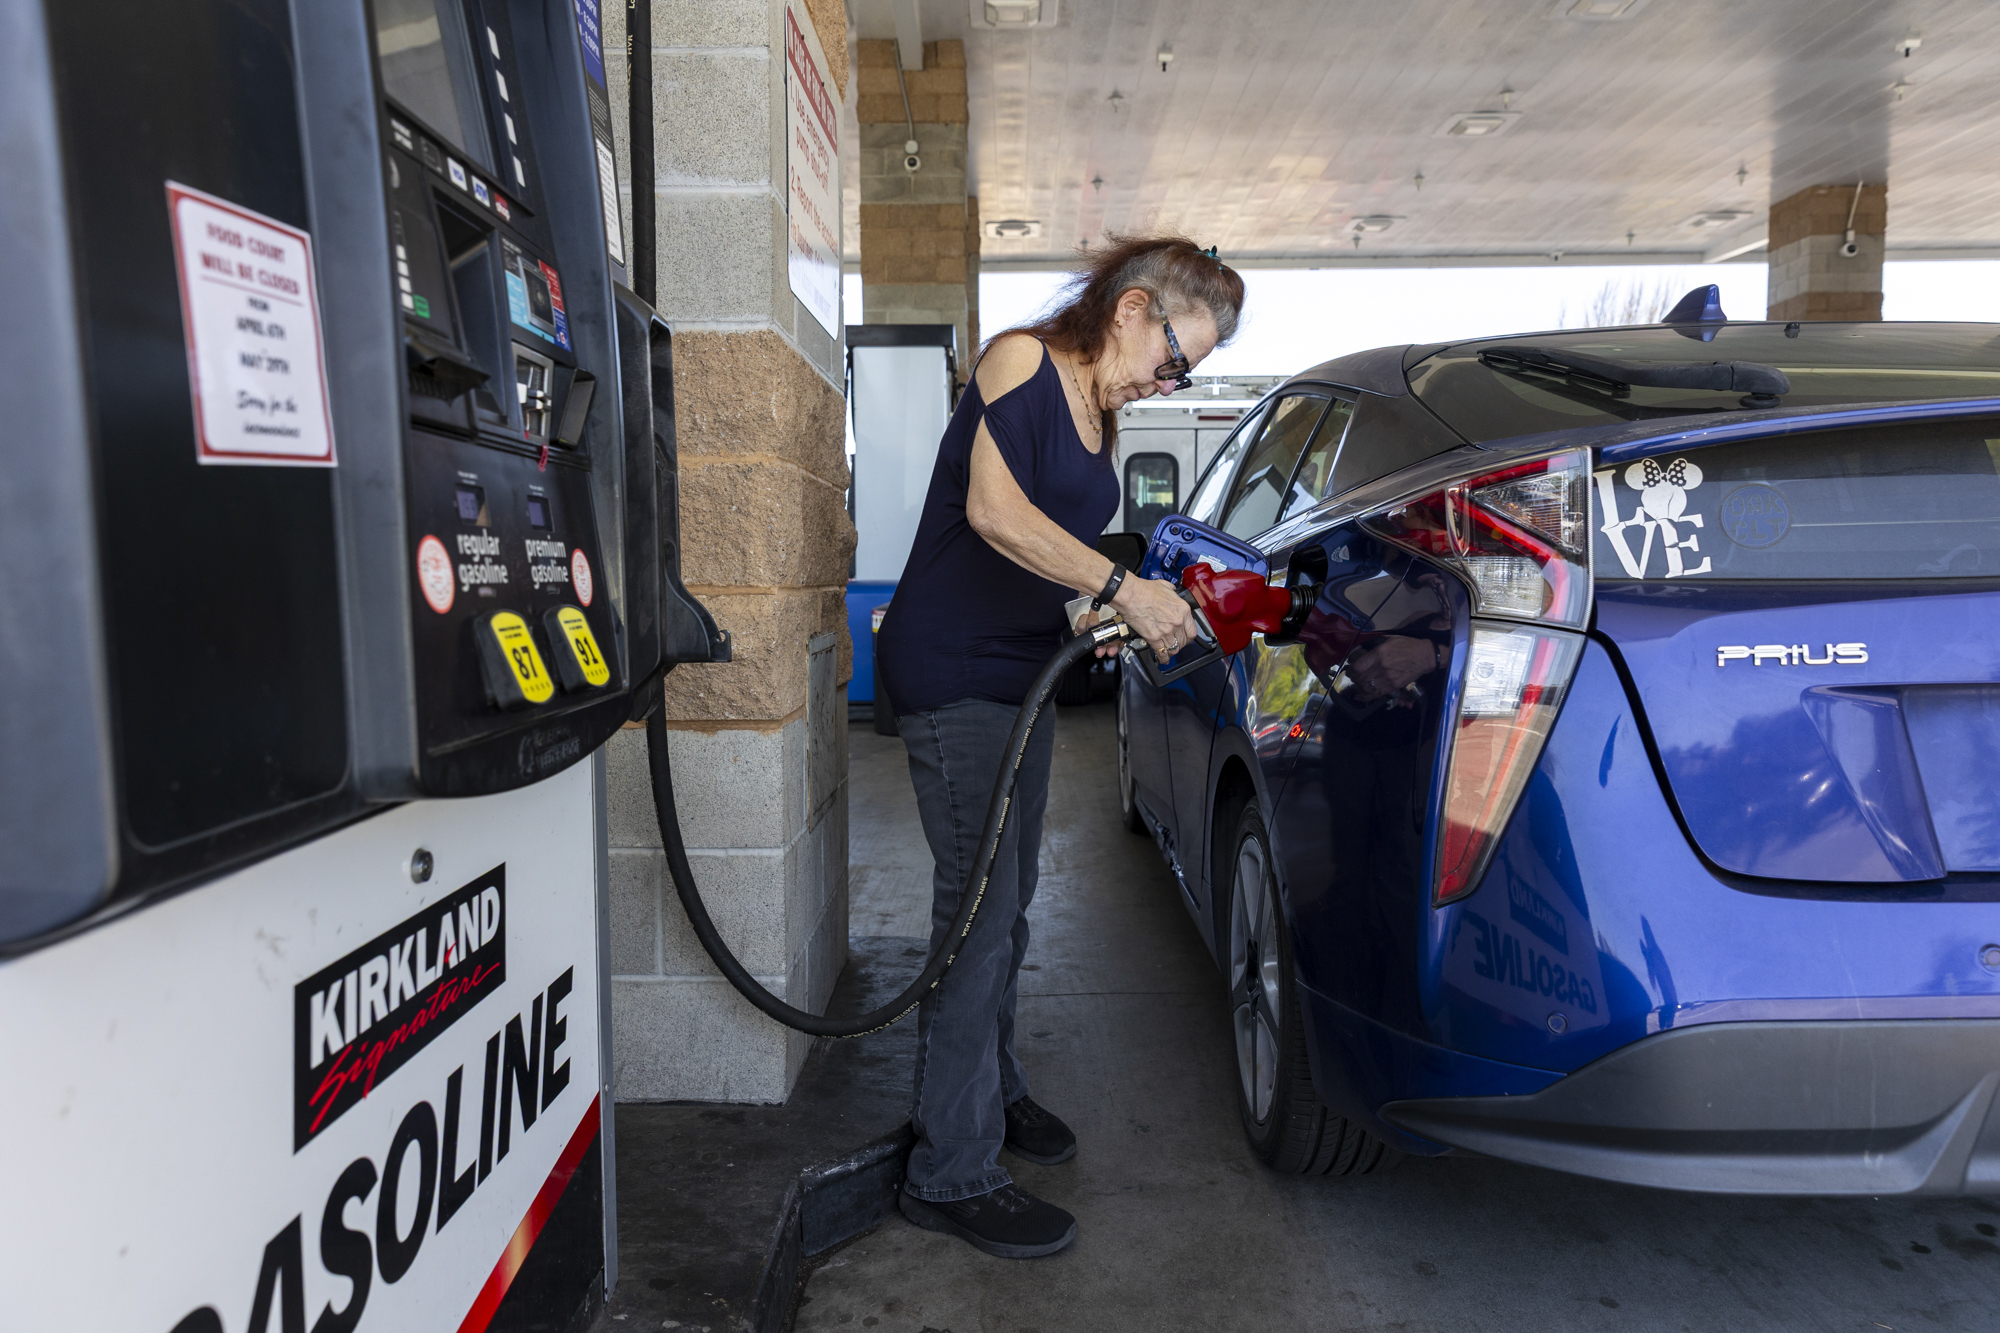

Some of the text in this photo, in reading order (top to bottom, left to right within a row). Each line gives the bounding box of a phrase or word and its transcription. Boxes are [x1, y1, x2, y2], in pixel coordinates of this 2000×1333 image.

[787, 15, 794, 54] IN
[794, 31, 805, 80] CASE
[805, 57, 812, 92] OF
[812, 70, 821, 112] FIRE
[826, 103, 837, 146] SPILL
[795, 84, 805, 123] Use
[806, 114, 829, 173] emergency
[796, 125, 809, 165] pump
[797, 174, 812, 220] Report
[813, 202, 821, 232] the
[206, 222, 286, 264] FOOD COURT
[199, 251, 301, 296] WILL BE CLOSED
[236, 317, 264, 337] APRIL
[239, 353, 263, 371] MAY
[237, 389, 267, 415] Sorry
[285, 397, 298, 414] the
[1728, 493, 1785, 517] OAK
[456, 528, 500, 562] regular
[1730, 517, 1785, 541] CLT
[524, 535, 567, 563] premium
[458, 557, 509, 592] gasoline
[530, 557, 570, 590] gasoline
[512, 645, 538, 680] 87
[575, 636, 600, 667] 91
[1716, 642, 1870, 668] PRIUS
[1019, 727, 1032, 754] Gasoline
[1014, 754, 1023, 770] hose
[968, 913, 976, 922] in
[971, 894, 982, 914] Made
[960, 922, 972, 938] USA
[309, 884, 500, 1070] KIRKLAND
[308, 961, 501, 1134] Signature
[165, 963, 575, 1333] ASOLINE
